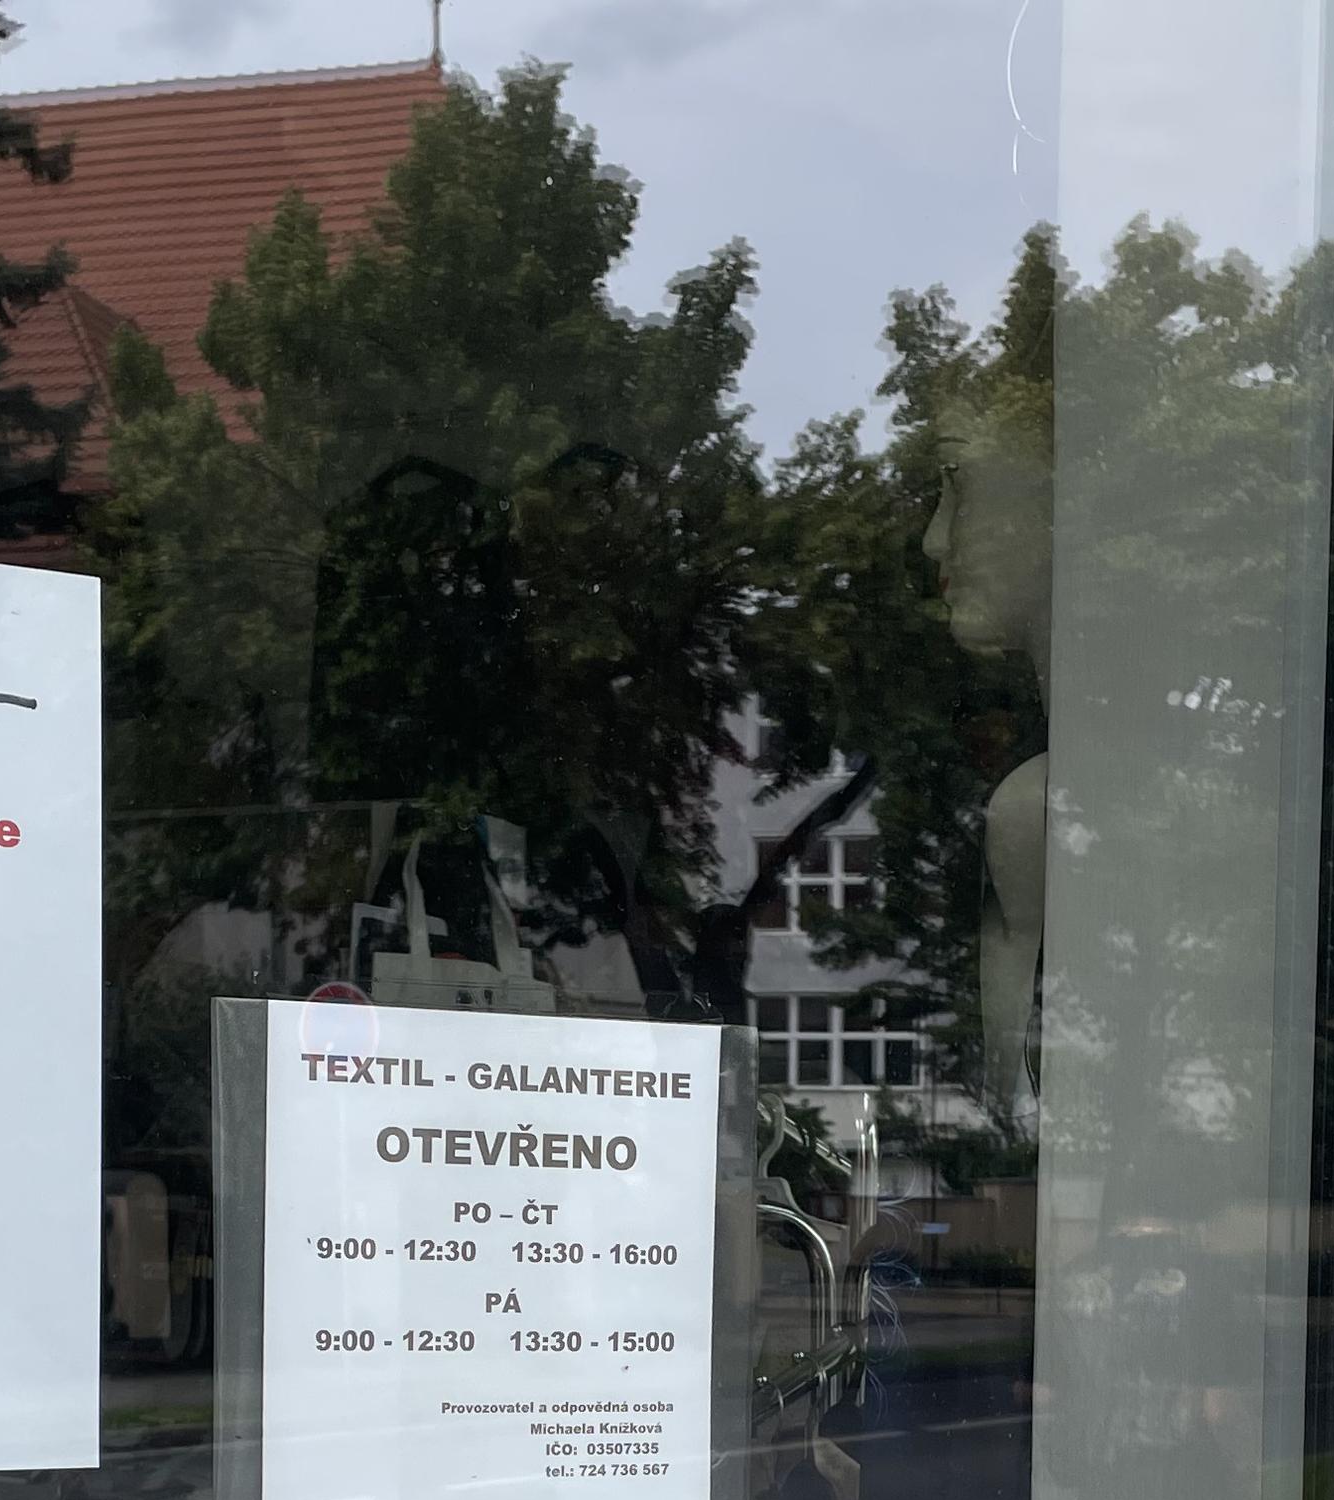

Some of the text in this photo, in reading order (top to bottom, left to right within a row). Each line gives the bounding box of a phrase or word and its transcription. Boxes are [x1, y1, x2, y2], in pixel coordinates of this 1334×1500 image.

[300, 1053, 434, 1087] TEXTIL
[467, 1062, 691, 1100] GALANTERIE
[376, 1123, 637, 1171] OTEVŘENO
[454, 1202, 492, 1224] PO
[521, 1198, 559, 1225] ČT
[316, 1237, 377, 1260] 9:00
[403, 1239, 477, 1262] 12:30
[511, 1241, 584, 1264] 13:30
[609, 1243, 678, 1266] 16:00
[485, 1287, 522, 1314] PÁ
[315, 1329, 375, 1352] 9:00
[402, 1330, 475, 1352] 12:30
[509, 1330, 582, 1352] 13:30
[607, 1331, 675, 1352] 15:00
[441, 1400, 674, 1416] Provozovatel a odpovědná osoba
[530, 1423, 595, 1435] Michaela
[546, 1441, 659, 1456] IČO: 03507335
[545, 1463, 670, 1478] tel.: 724 736 567
